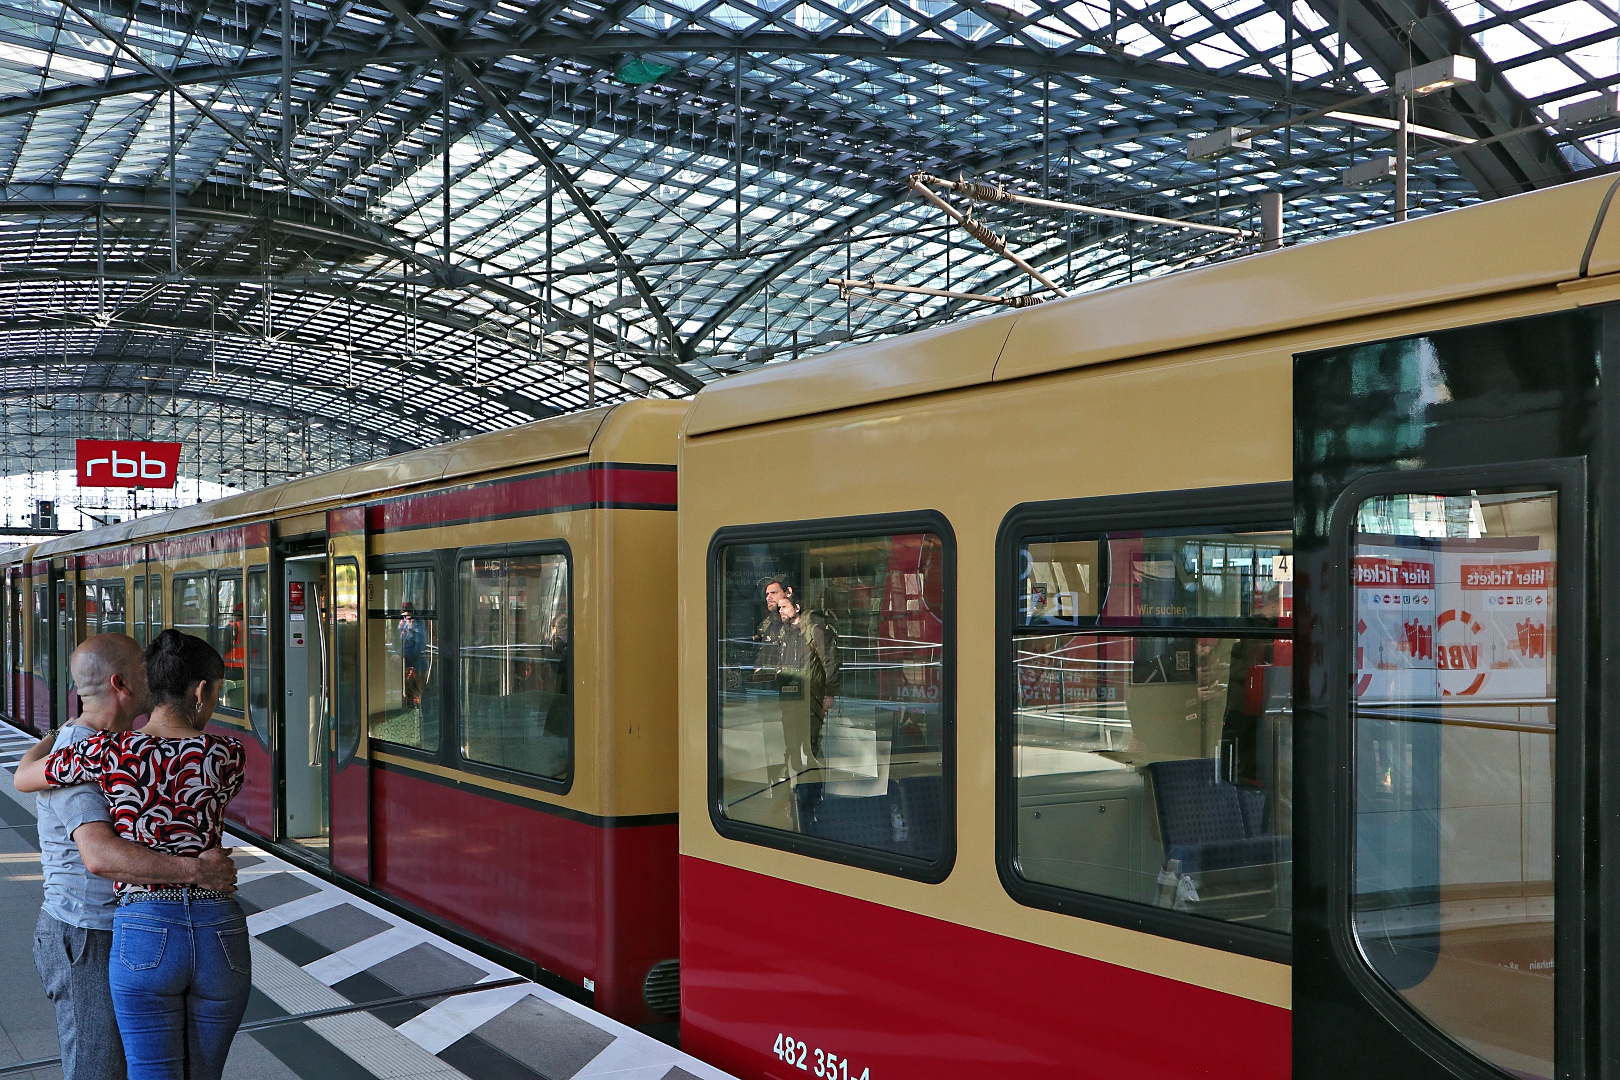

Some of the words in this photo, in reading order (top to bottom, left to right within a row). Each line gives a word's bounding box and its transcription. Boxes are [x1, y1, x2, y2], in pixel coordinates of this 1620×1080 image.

[86, 450, 166, 478] rbb
[1137, 604, 1153, 615] Wir
[1155, 604, 1187, 615] suchen
[773, 1032, 808, 1071] 482
